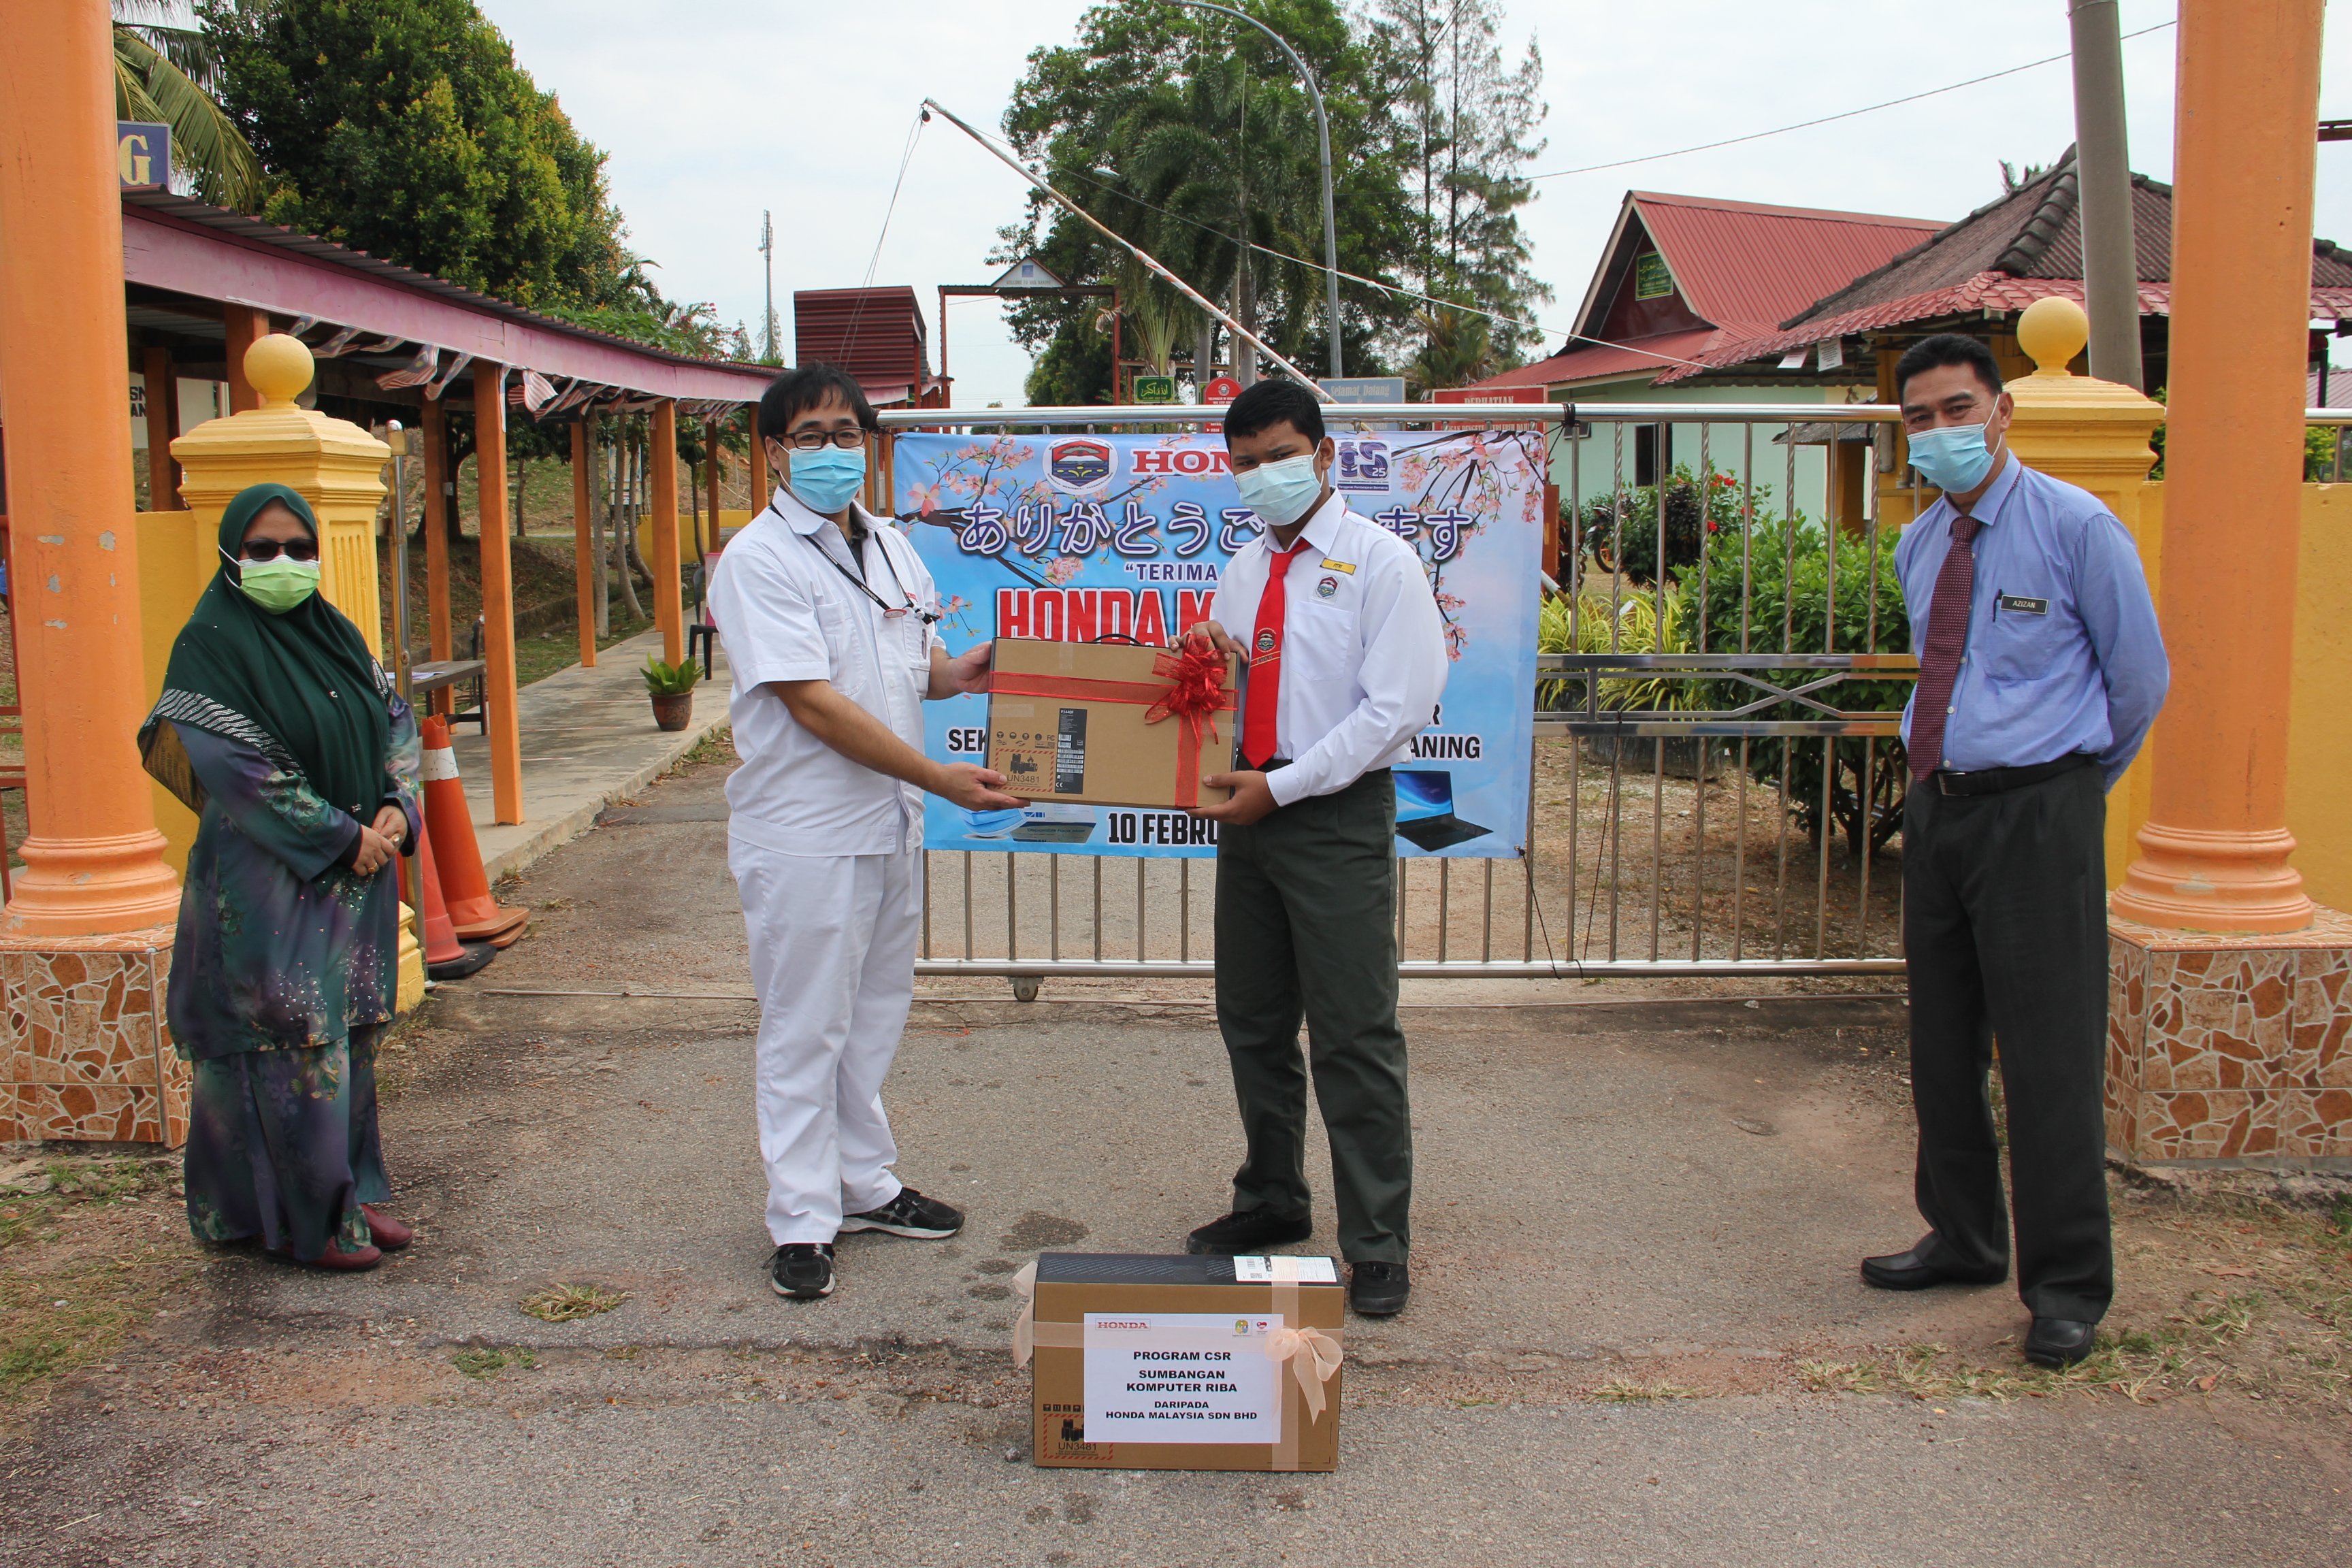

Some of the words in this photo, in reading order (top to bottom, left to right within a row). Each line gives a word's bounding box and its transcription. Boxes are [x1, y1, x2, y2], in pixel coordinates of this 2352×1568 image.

[1330, 385, 1360, 397] Selamat
[1363, 385, 1390, 397] Datang
[1132, 451, 1233, 473] HON
[1372, 468, 1386, 476] 25
[2012, 600, 2036, 608] AZIZAN
[998, 590, 1168, 646] HONDA
[1410, 736, 1480, 759] ANING
[1007, 774, 1039, 783] UN3481
[1108, 813, 1137, 844] 10
[1143, 814, 1217, 845] FEBRU
[1133, 1352, 1200, 1360] PROGRAM
[1205, 1352, 1231, 1360] CSR
[1139, 1370, 1225, 1379] SUMBANGAN
[1126, 1383, 1201, 1392] KOMPUTER
[1206, 1384, 1237, 1392] RIBA
[1058, 1442, 1096, 1451] UN3481
